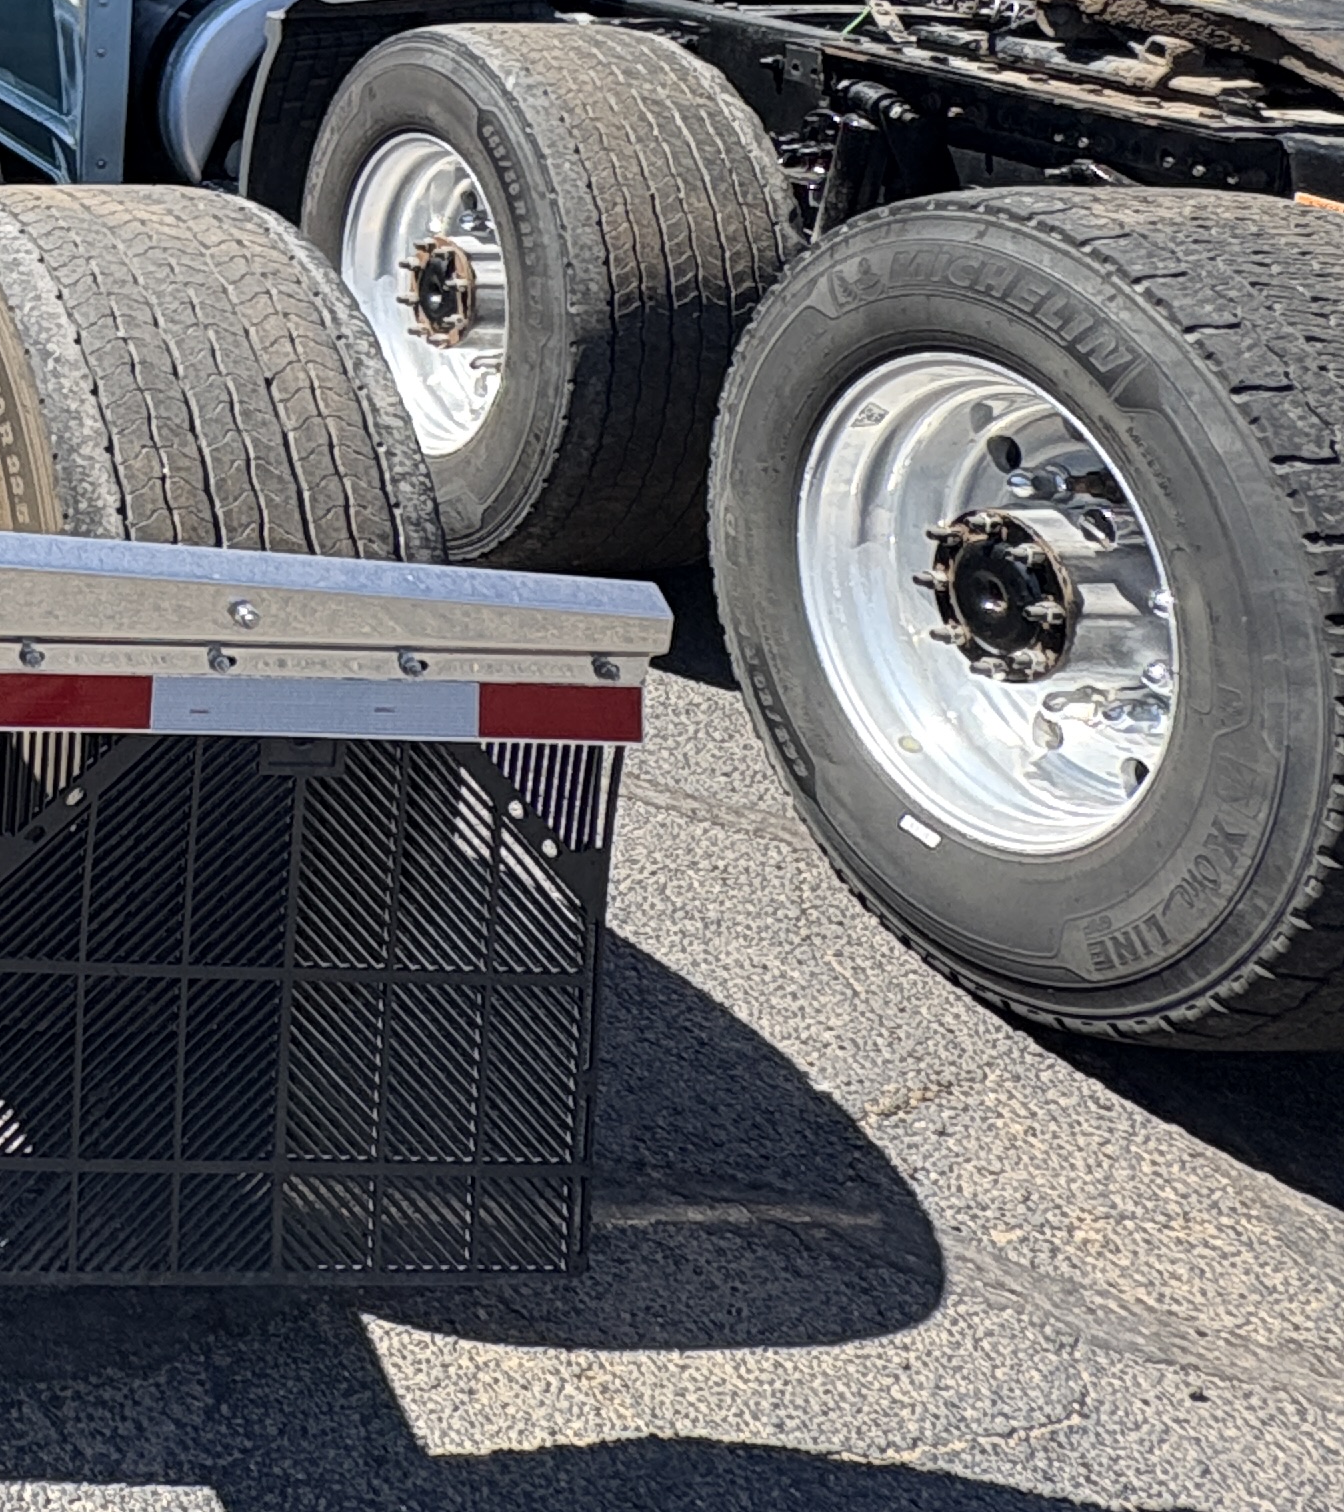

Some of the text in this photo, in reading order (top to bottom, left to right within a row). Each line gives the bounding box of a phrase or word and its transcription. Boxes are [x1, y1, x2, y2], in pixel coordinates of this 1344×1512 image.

[888, 250, 1141, 373] MICHELIN
[6, 454, 30, 524] 22.5
[1086, 913, 1173, 972] LINE
